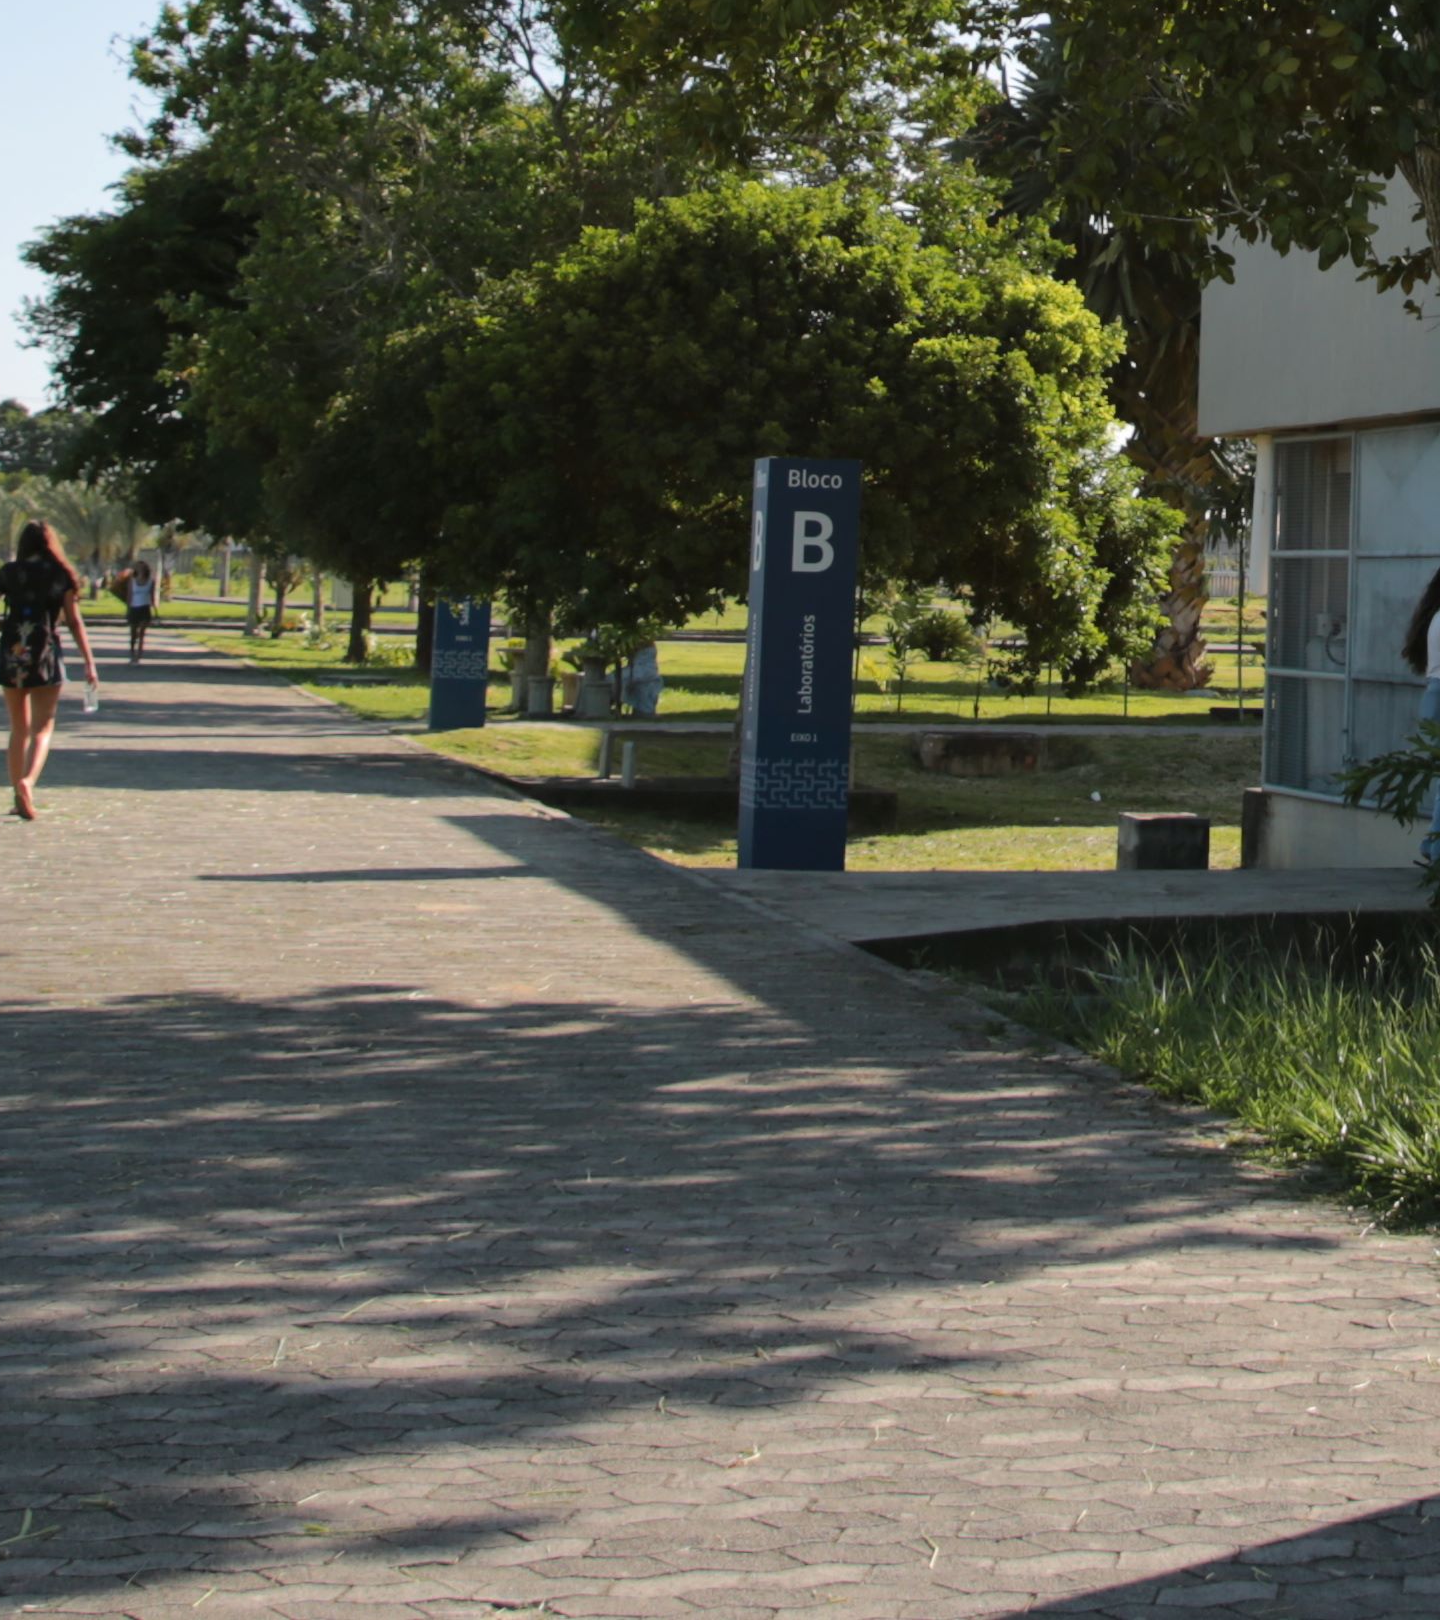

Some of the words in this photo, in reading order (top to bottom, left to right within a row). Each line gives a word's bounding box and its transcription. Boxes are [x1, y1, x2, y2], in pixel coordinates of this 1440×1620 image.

[787, 469, 843, 489] Bloco
[792, 511, 834, 573] B
[797, 614, 816, 714] Laboratórios
